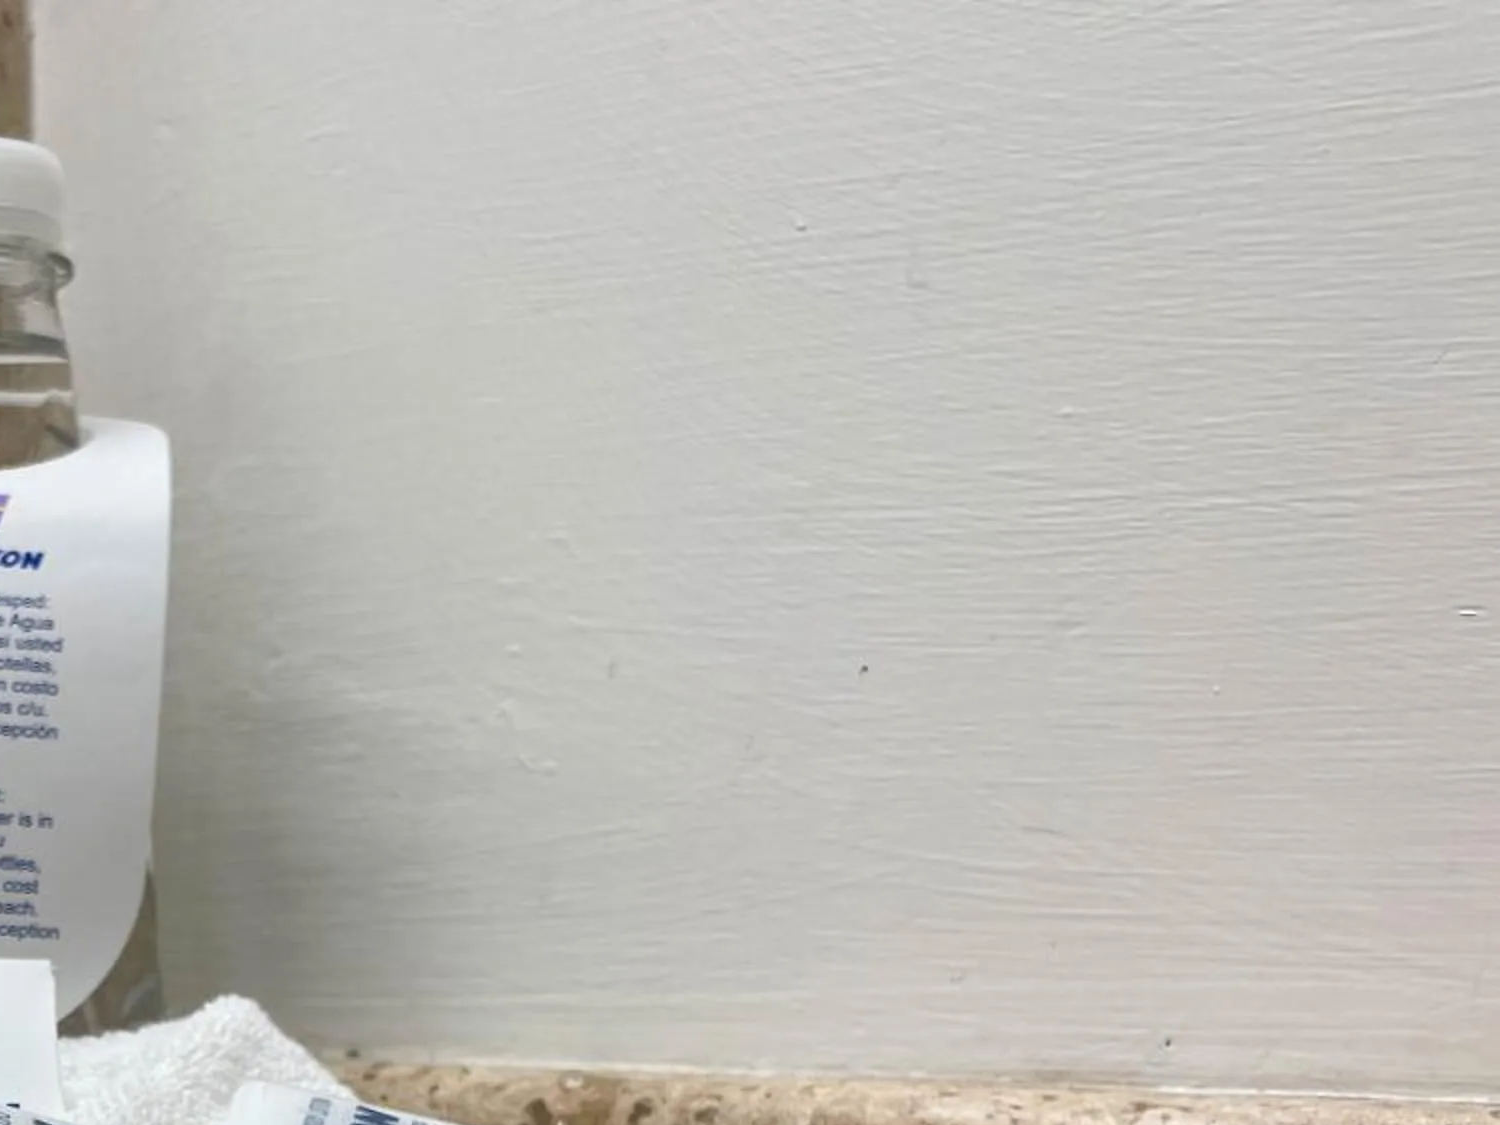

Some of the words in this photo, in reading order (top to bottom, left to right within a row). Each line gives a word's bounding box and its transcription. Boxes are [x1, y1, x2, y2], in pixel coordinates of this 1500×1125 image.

[9, 613, 55, 632] Agua
[15, 636, 65, 652] usted
[11, 680, 59, 696] costo
[18, 812, 33, 828] is
[38, 812, 54, 829] in
[2, 877, 38, 894] cost
